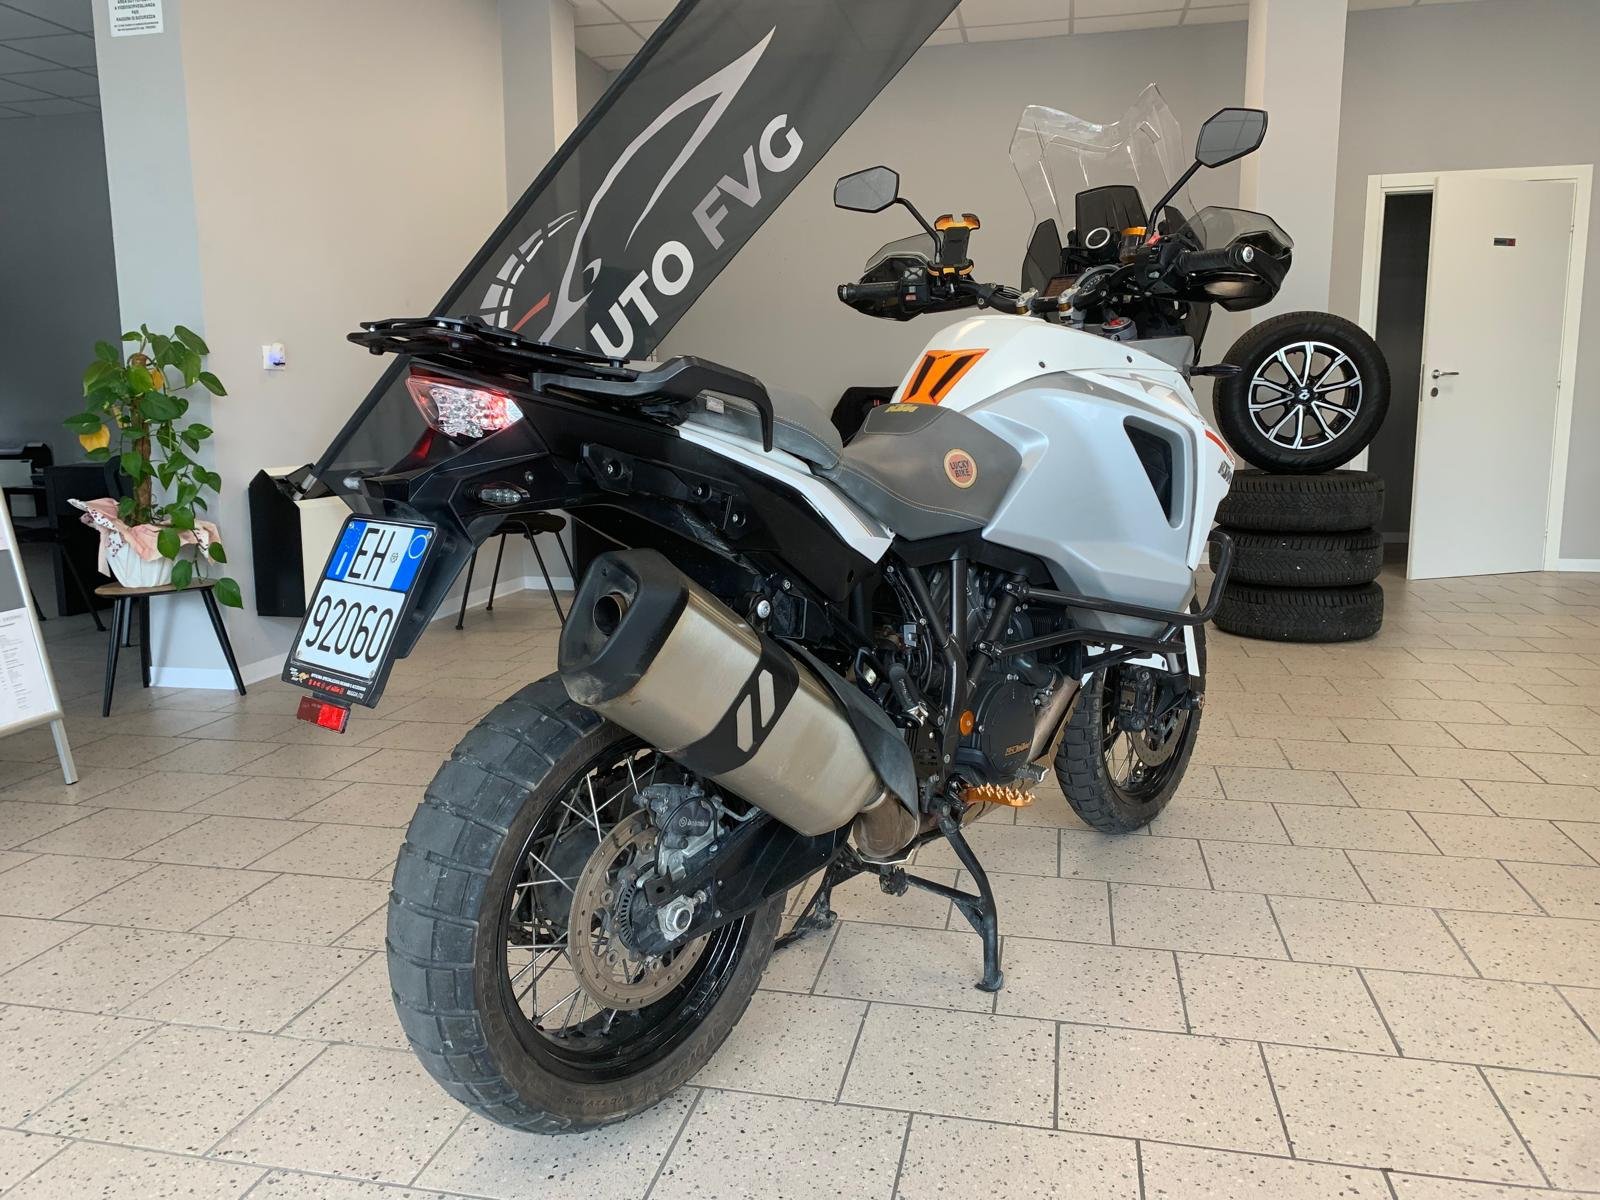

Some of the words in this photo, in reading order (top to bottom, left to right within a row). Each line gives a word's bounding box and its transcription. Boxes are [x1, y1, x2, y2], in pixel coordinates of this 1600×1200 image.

[584, 240, 694, 360] UTO
[692, 114, 804, 250] FVG
[949, 460, 969, 469] LUCKY
[955, 468, 971, 478] BIKE
[348, 527, 396, 581] EH
[305, 595, 394, 663] 92060
